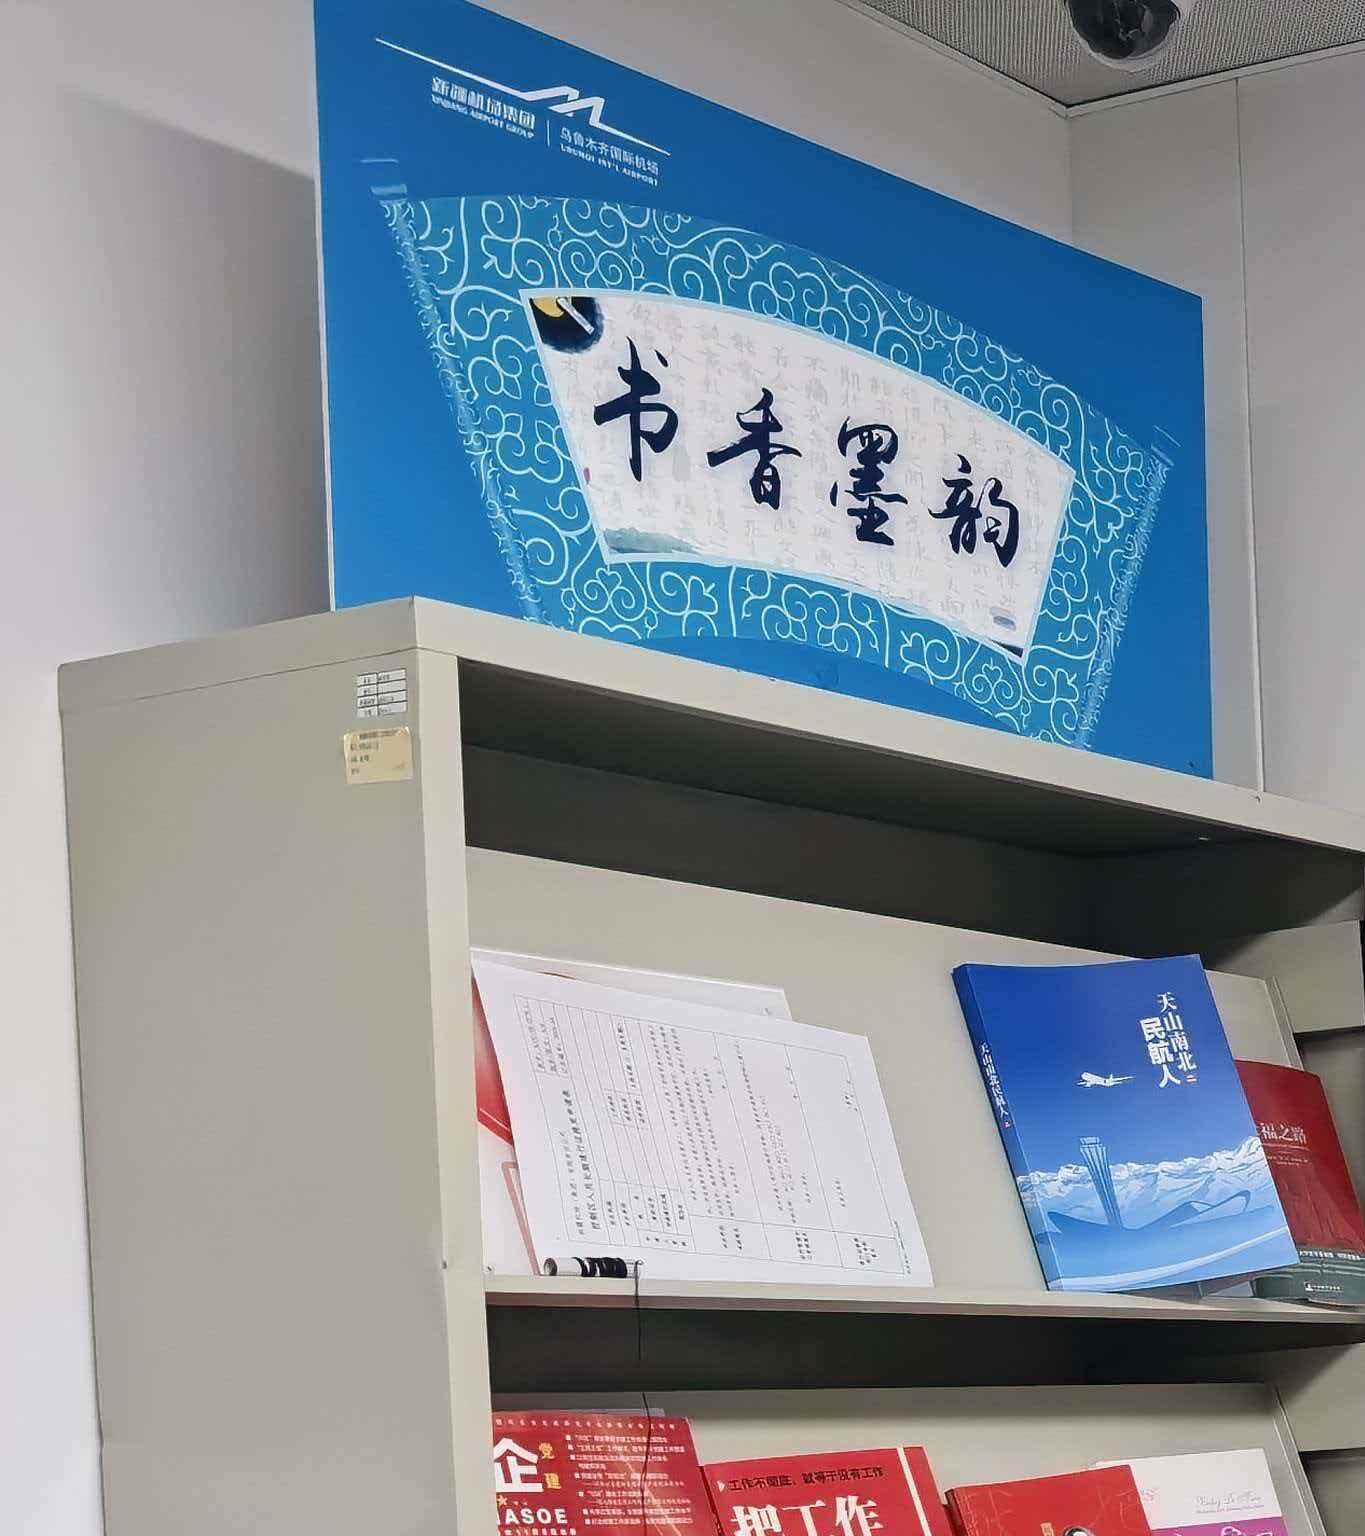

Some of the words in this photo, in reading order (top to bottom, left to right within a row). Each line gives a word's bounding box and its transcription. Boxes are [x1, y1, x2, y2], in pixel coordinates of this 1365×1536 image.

[560, 127, 659, 176] 乌鲁木齐国际机场
[593, 335, 1020, 569] 书香墨韵
[1139, 1016, 1181, 1088] 民航人
[1156, 991, 1197, 1073] 天山南北
[496, 1507, 569, 1527] ASOE
